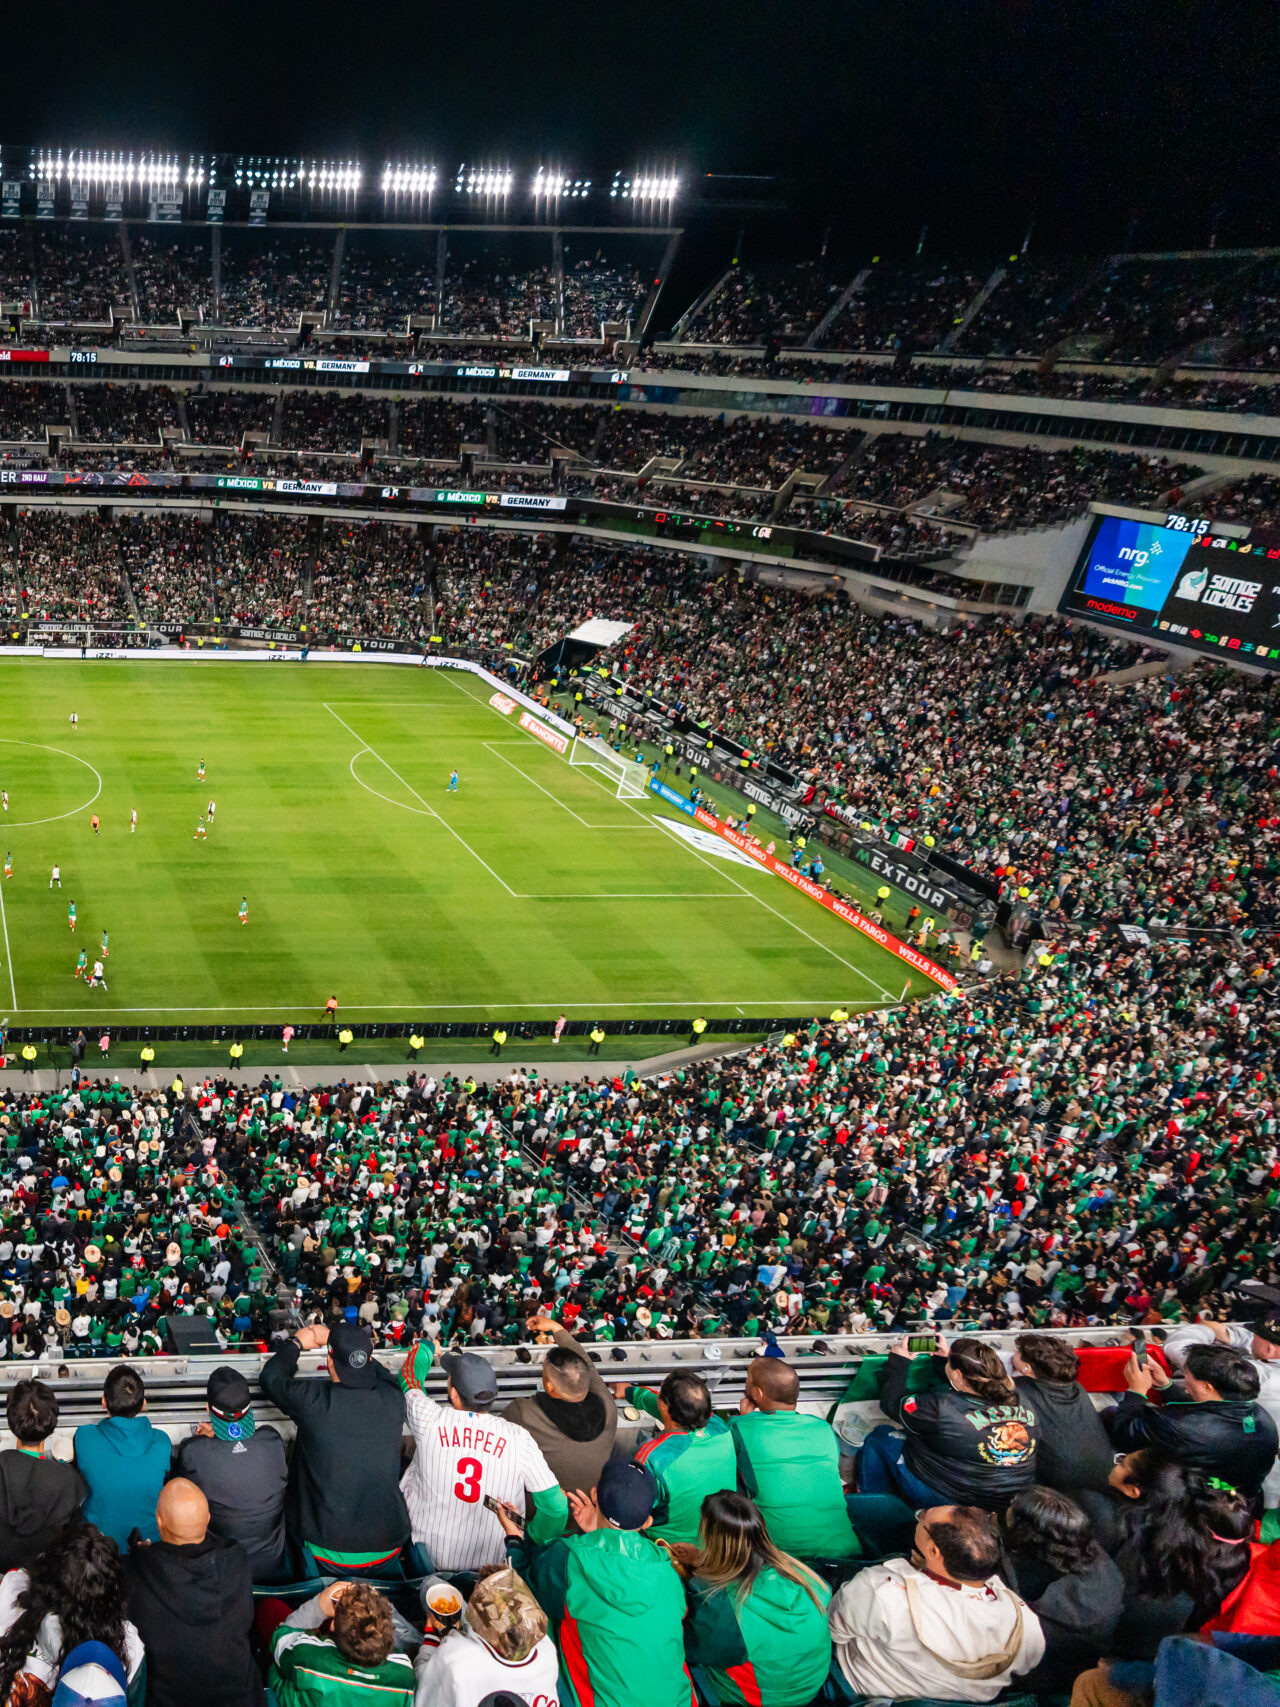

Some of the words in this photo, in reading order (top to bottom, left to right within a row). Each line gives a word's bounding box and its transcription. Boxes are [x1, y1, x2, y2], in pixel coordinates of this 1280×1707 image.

[72, 352, 96, 362] 78:15
[304, 361, 316, 369] VS.
[322, 362, 357, 370] GERMANY
[499, 368, 512, 378] VS.
[518, 370, 556, 379] GERMANY
[32, 473, 47, 482] HALF
[262, 480, 276, 490] VS.
[282, 482, 323, 492] GERMANY
[486, 495, 500, 504] VS.
[507, 497, 552, 506] GERMANY
[1166, 514, 1210, 534] 78:15
[1118, 547, 1148, 567] nrg
[1087, 600, 1137, 619] moderna
[1202, 591, 1256, 614] LOCALES
[272, 633, 297, 641] LOCALES
[528, 720, 566, 750] BANORTE
[696, 810, 717, 828] FARGO
[724, 828, 745, 848] WELLS
[745, 842, 766, 861] FARGO
[774, 862, 798, 883] WELLS
[798, 878, 823, 900] FARGO
[856, 848, 945, 908] MEXTOUR
[832, 900, 859, 924] WELLS
[859, 919, 888, 943] FARGO
[898, 945, 930, 972] WELLS
[965, 1405, 1035, 1431] MEXICO
[438, 1426, 506, 1458] HARPER
[454, 1457, 482, 1503] 3
